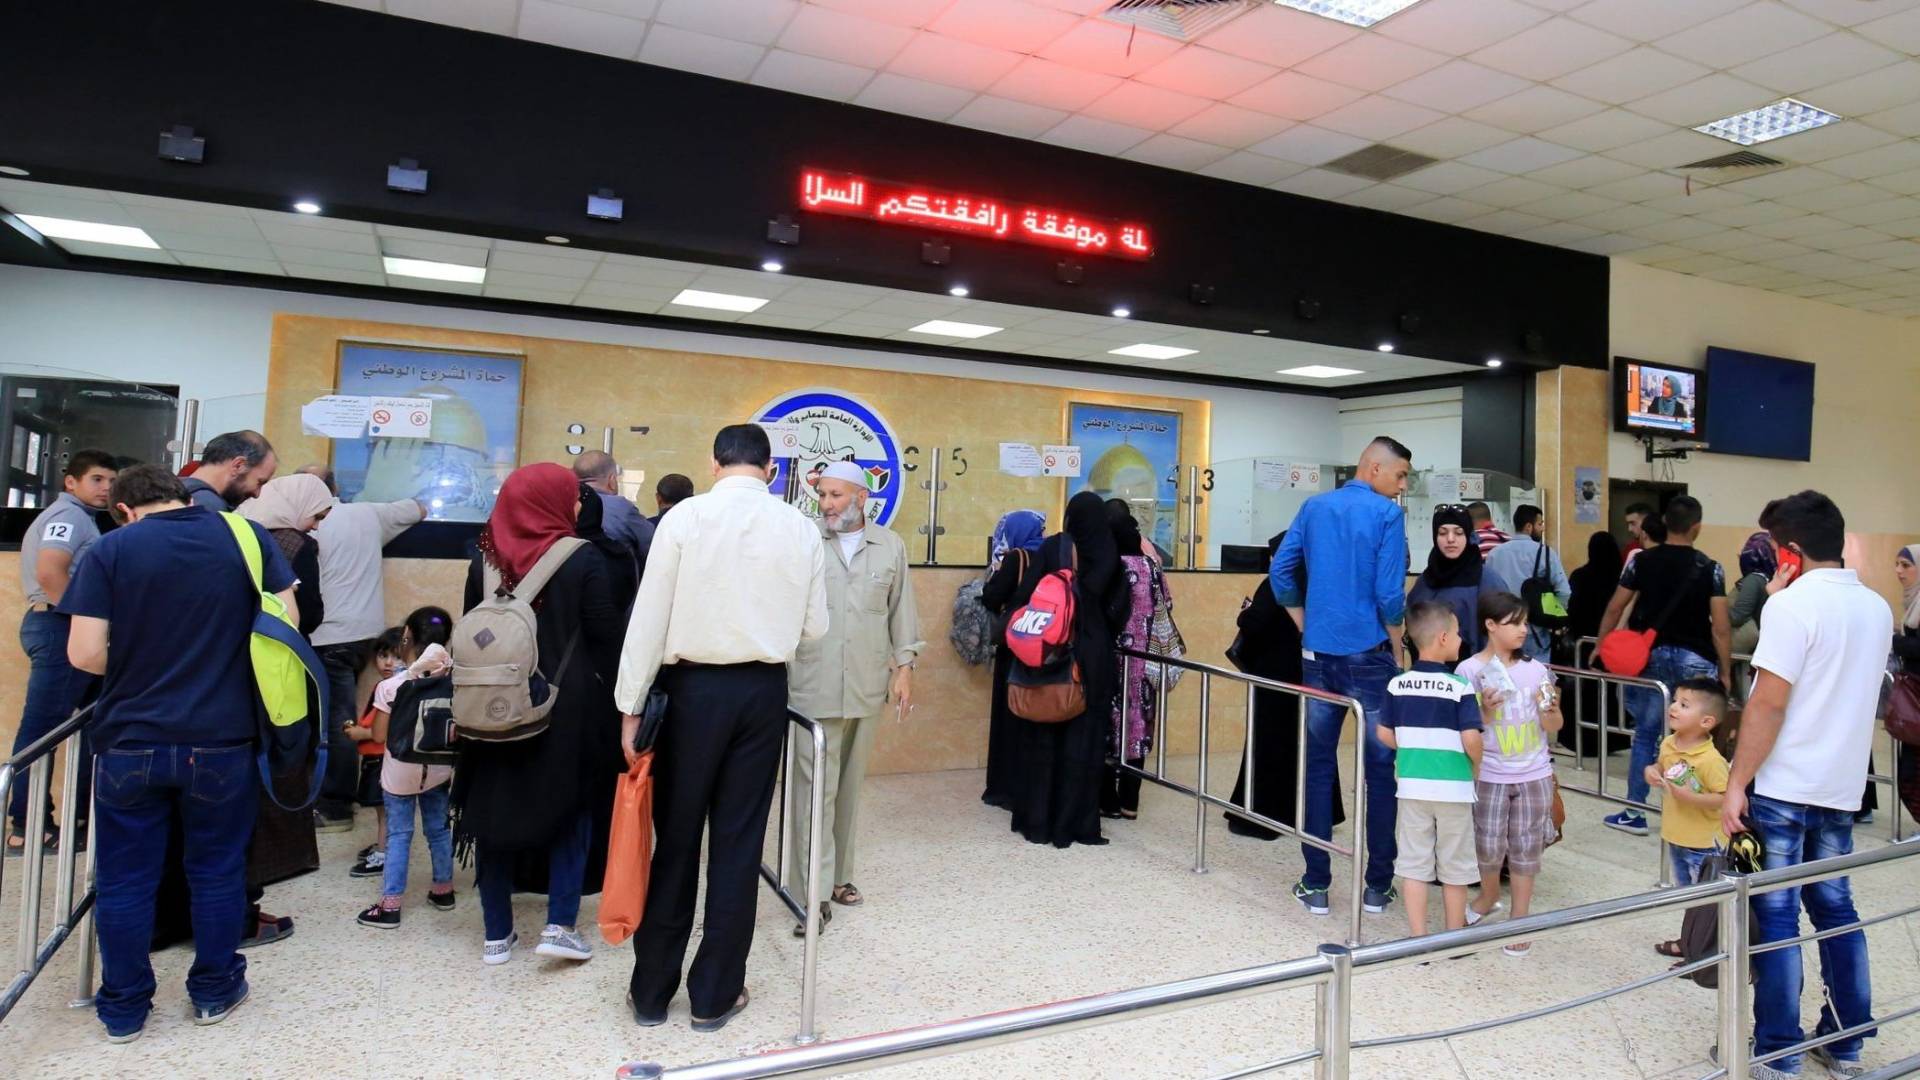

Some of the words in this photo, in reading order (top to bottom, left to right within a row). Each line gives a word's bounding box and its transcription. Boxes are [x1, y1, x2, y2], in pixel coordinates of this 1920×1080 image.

[879, 195, 1008, 234] رافقتكم
[1022, 211, 1107, 249] موفقة
[362, 360, 415, 379] الوطني
[420, 365, 472, 381] المشروع
[952, 447, 968, 476] 5
[1202, 469, 1214, 491] 3
[49, 525, 67, 537] 12
[1397, 680, 1454, 693] NAUTICA
